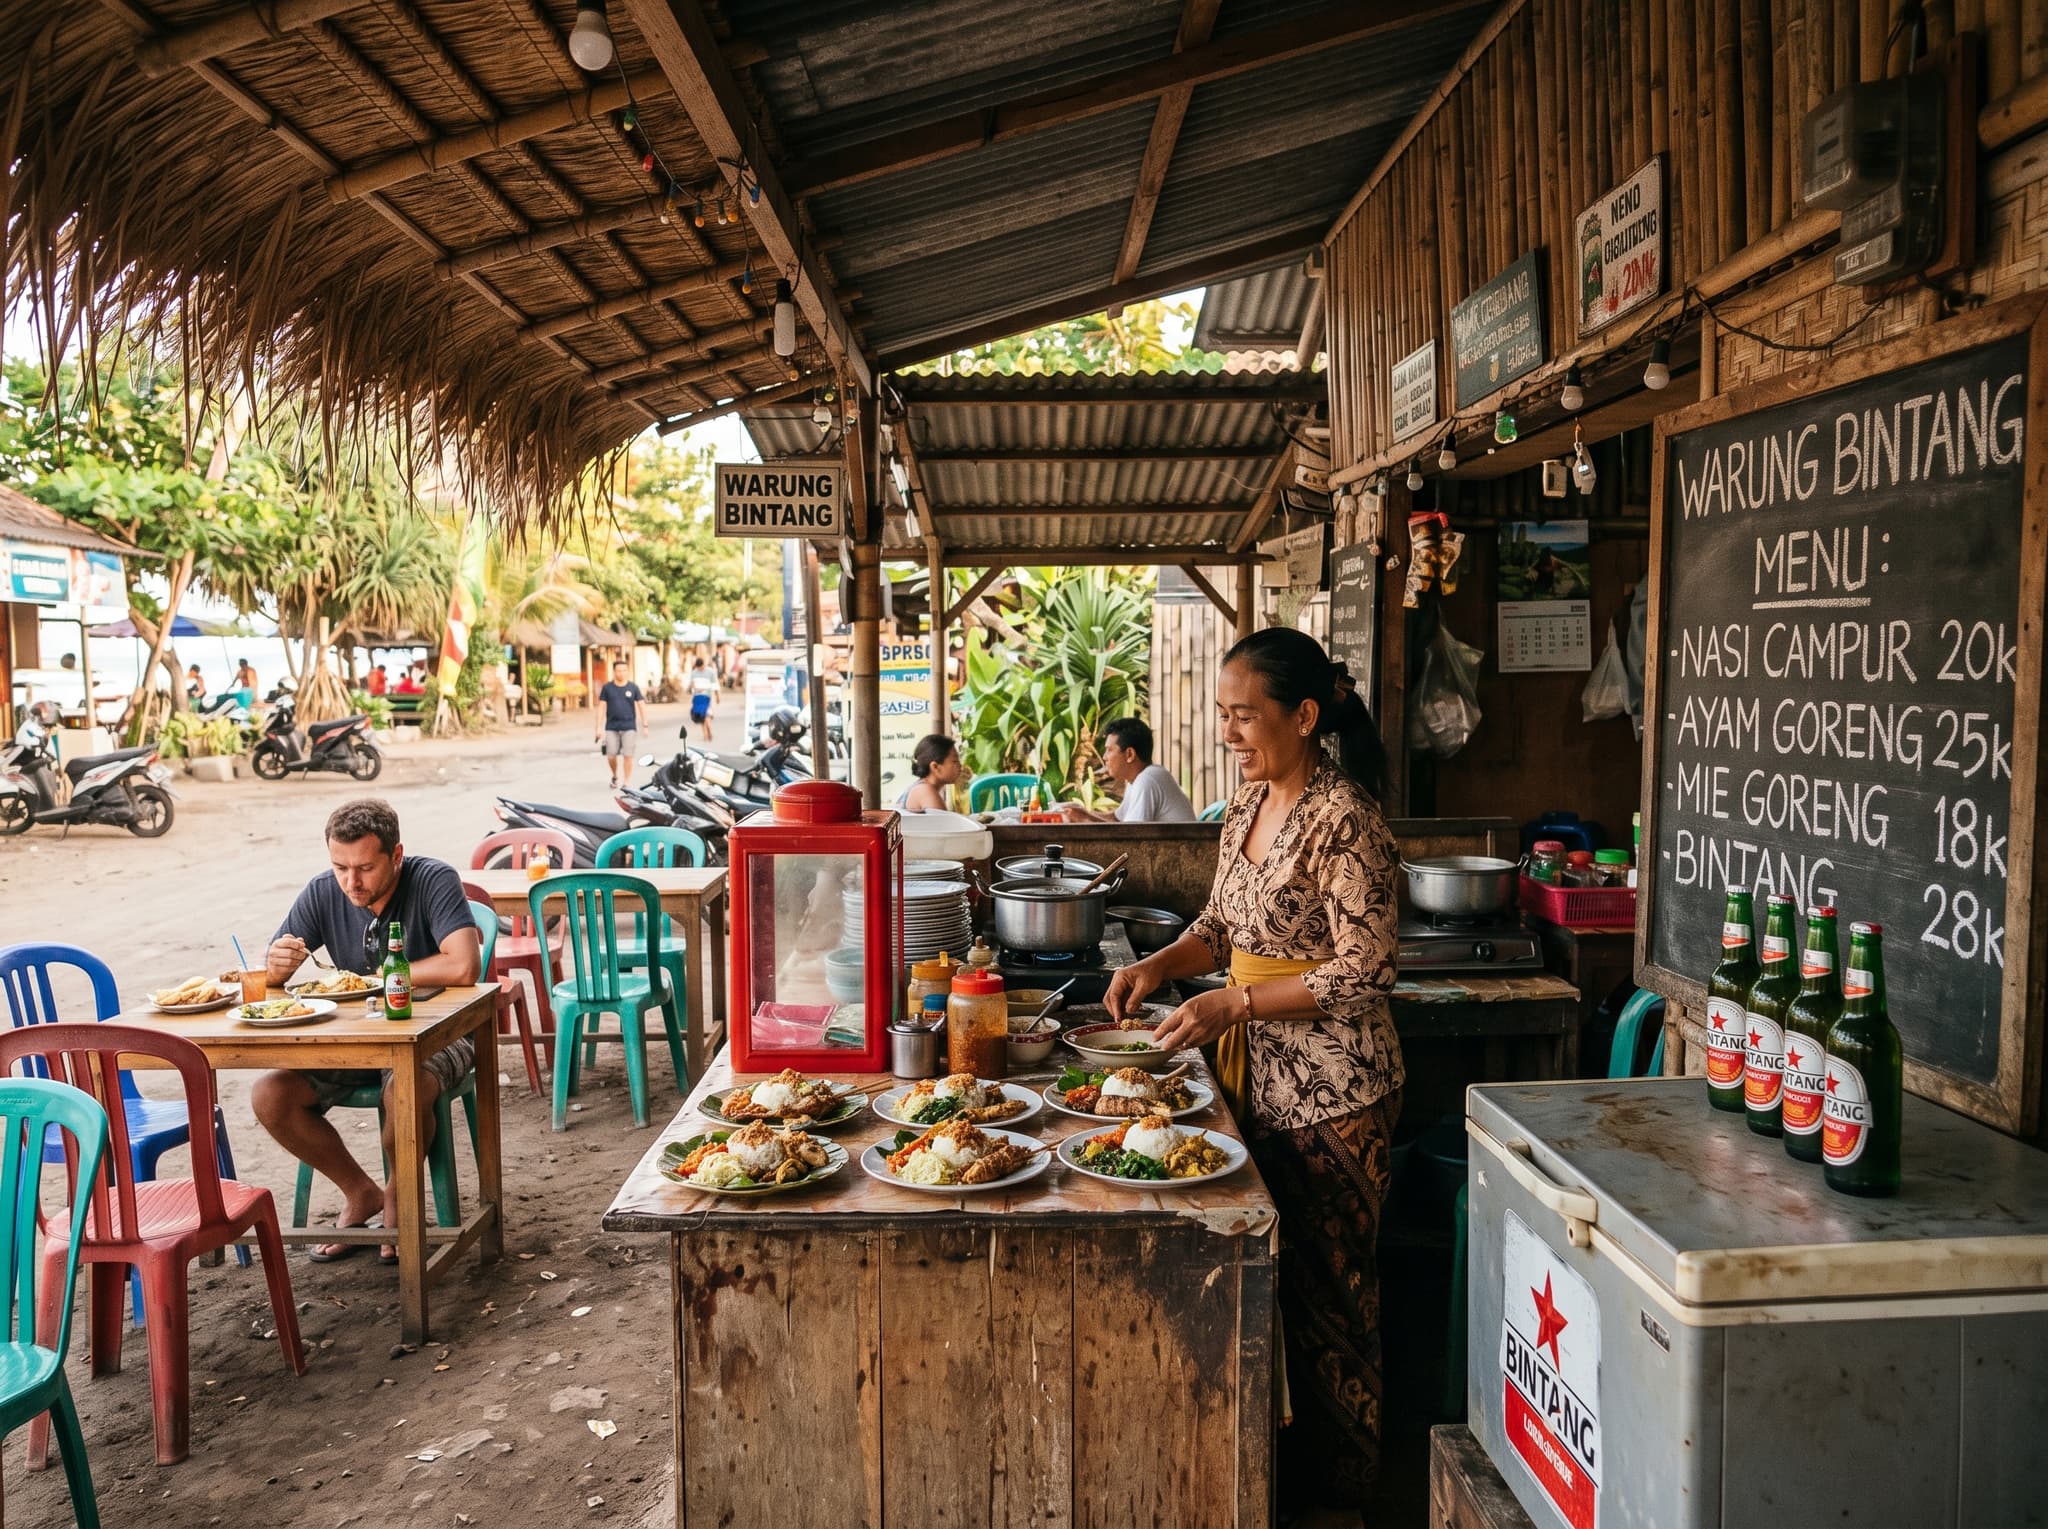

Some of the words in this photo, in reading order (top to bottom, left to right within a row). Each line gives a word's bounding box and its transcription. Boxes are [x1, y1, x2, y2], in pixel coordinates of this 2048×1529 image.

[724, 473, 833, 498] WARUNG
[1678, 424, 1818, 520] WARUNG
[1833, 374, 2024, 495] BINTANG
[725, 503, 833, 526] BINTANG
[1763, 620, 1918, 684] CAMPUR
[1937, 619, 2017, 683] 20k
[1772, 698, 1924, 772] GORENG
[1932, 709, 2012, 781] 25k
[1742, 769, 1890, 849] GORENG
[1933, 795, 2008, 879] 18k
[1921, 883, 2005, 969] 28k
[1506, 1330, 1595, 1469] BINTANG
